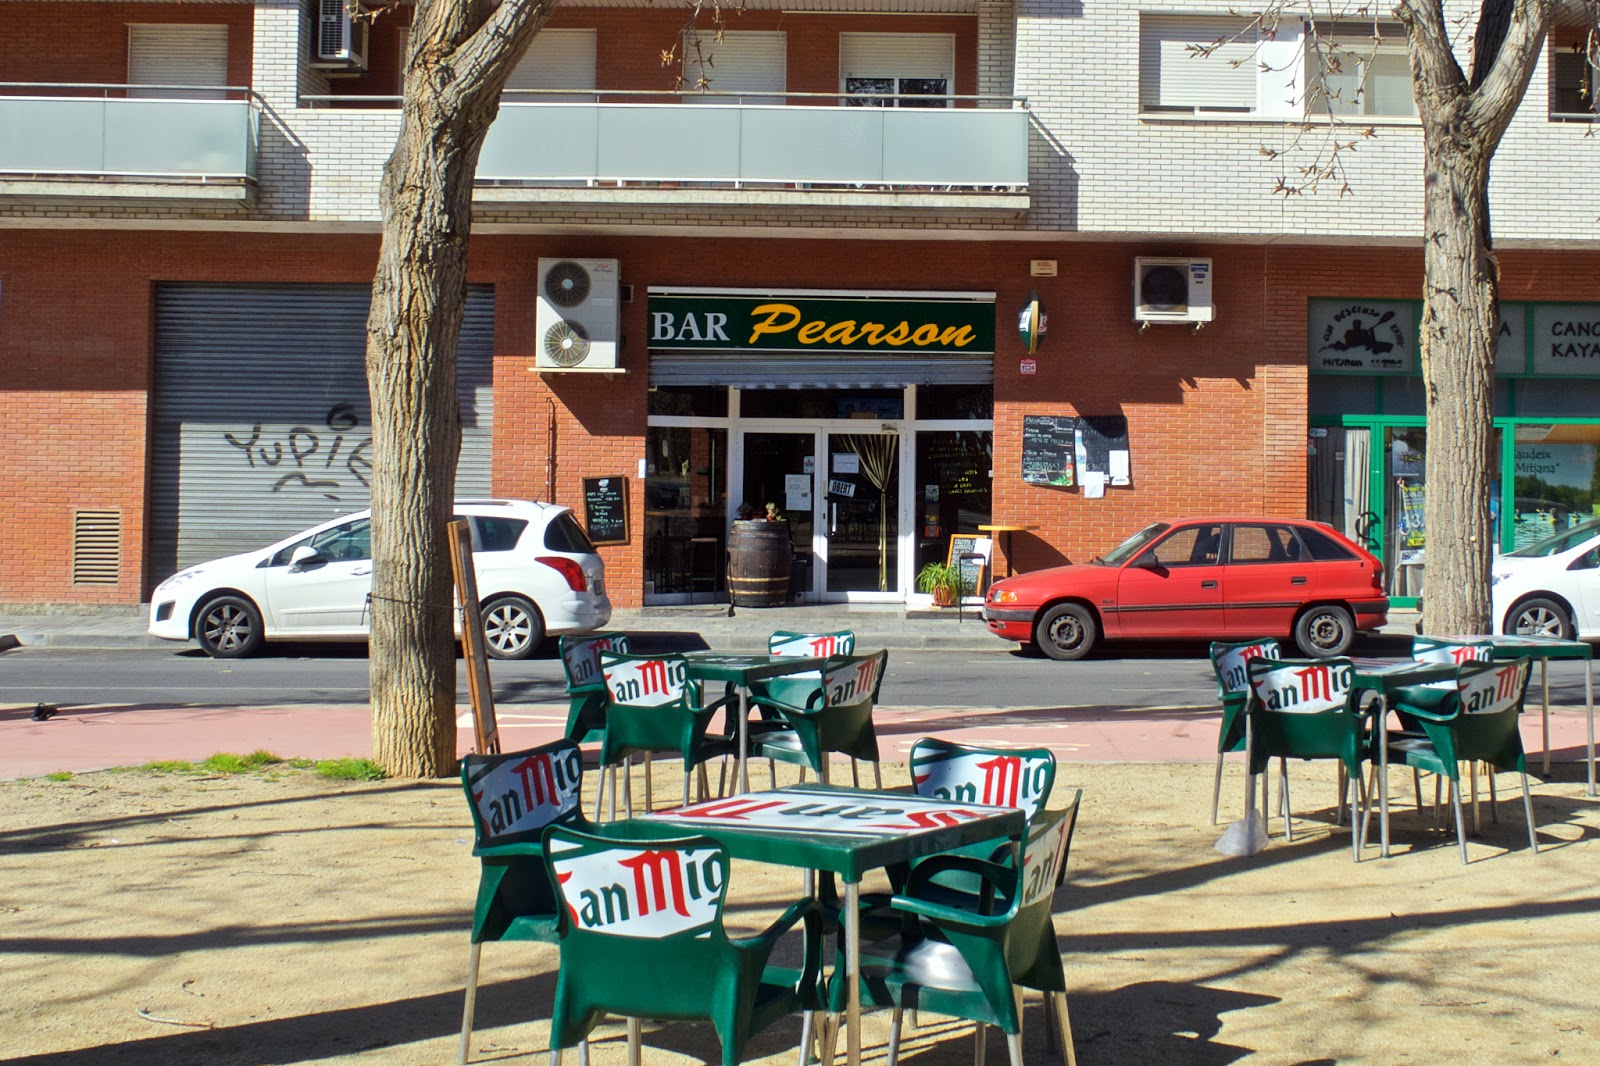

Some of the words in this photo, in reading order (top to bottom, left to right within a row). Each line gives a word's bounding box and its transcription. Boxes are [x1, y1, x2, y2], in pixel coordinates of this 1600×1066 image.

[1333, 305, 1380, 322] DESCENSO
[651, 311, 730, 342] BAR
[748, 303, 977, 347] Pearson
[832, 481, 852, 495] OBERT
